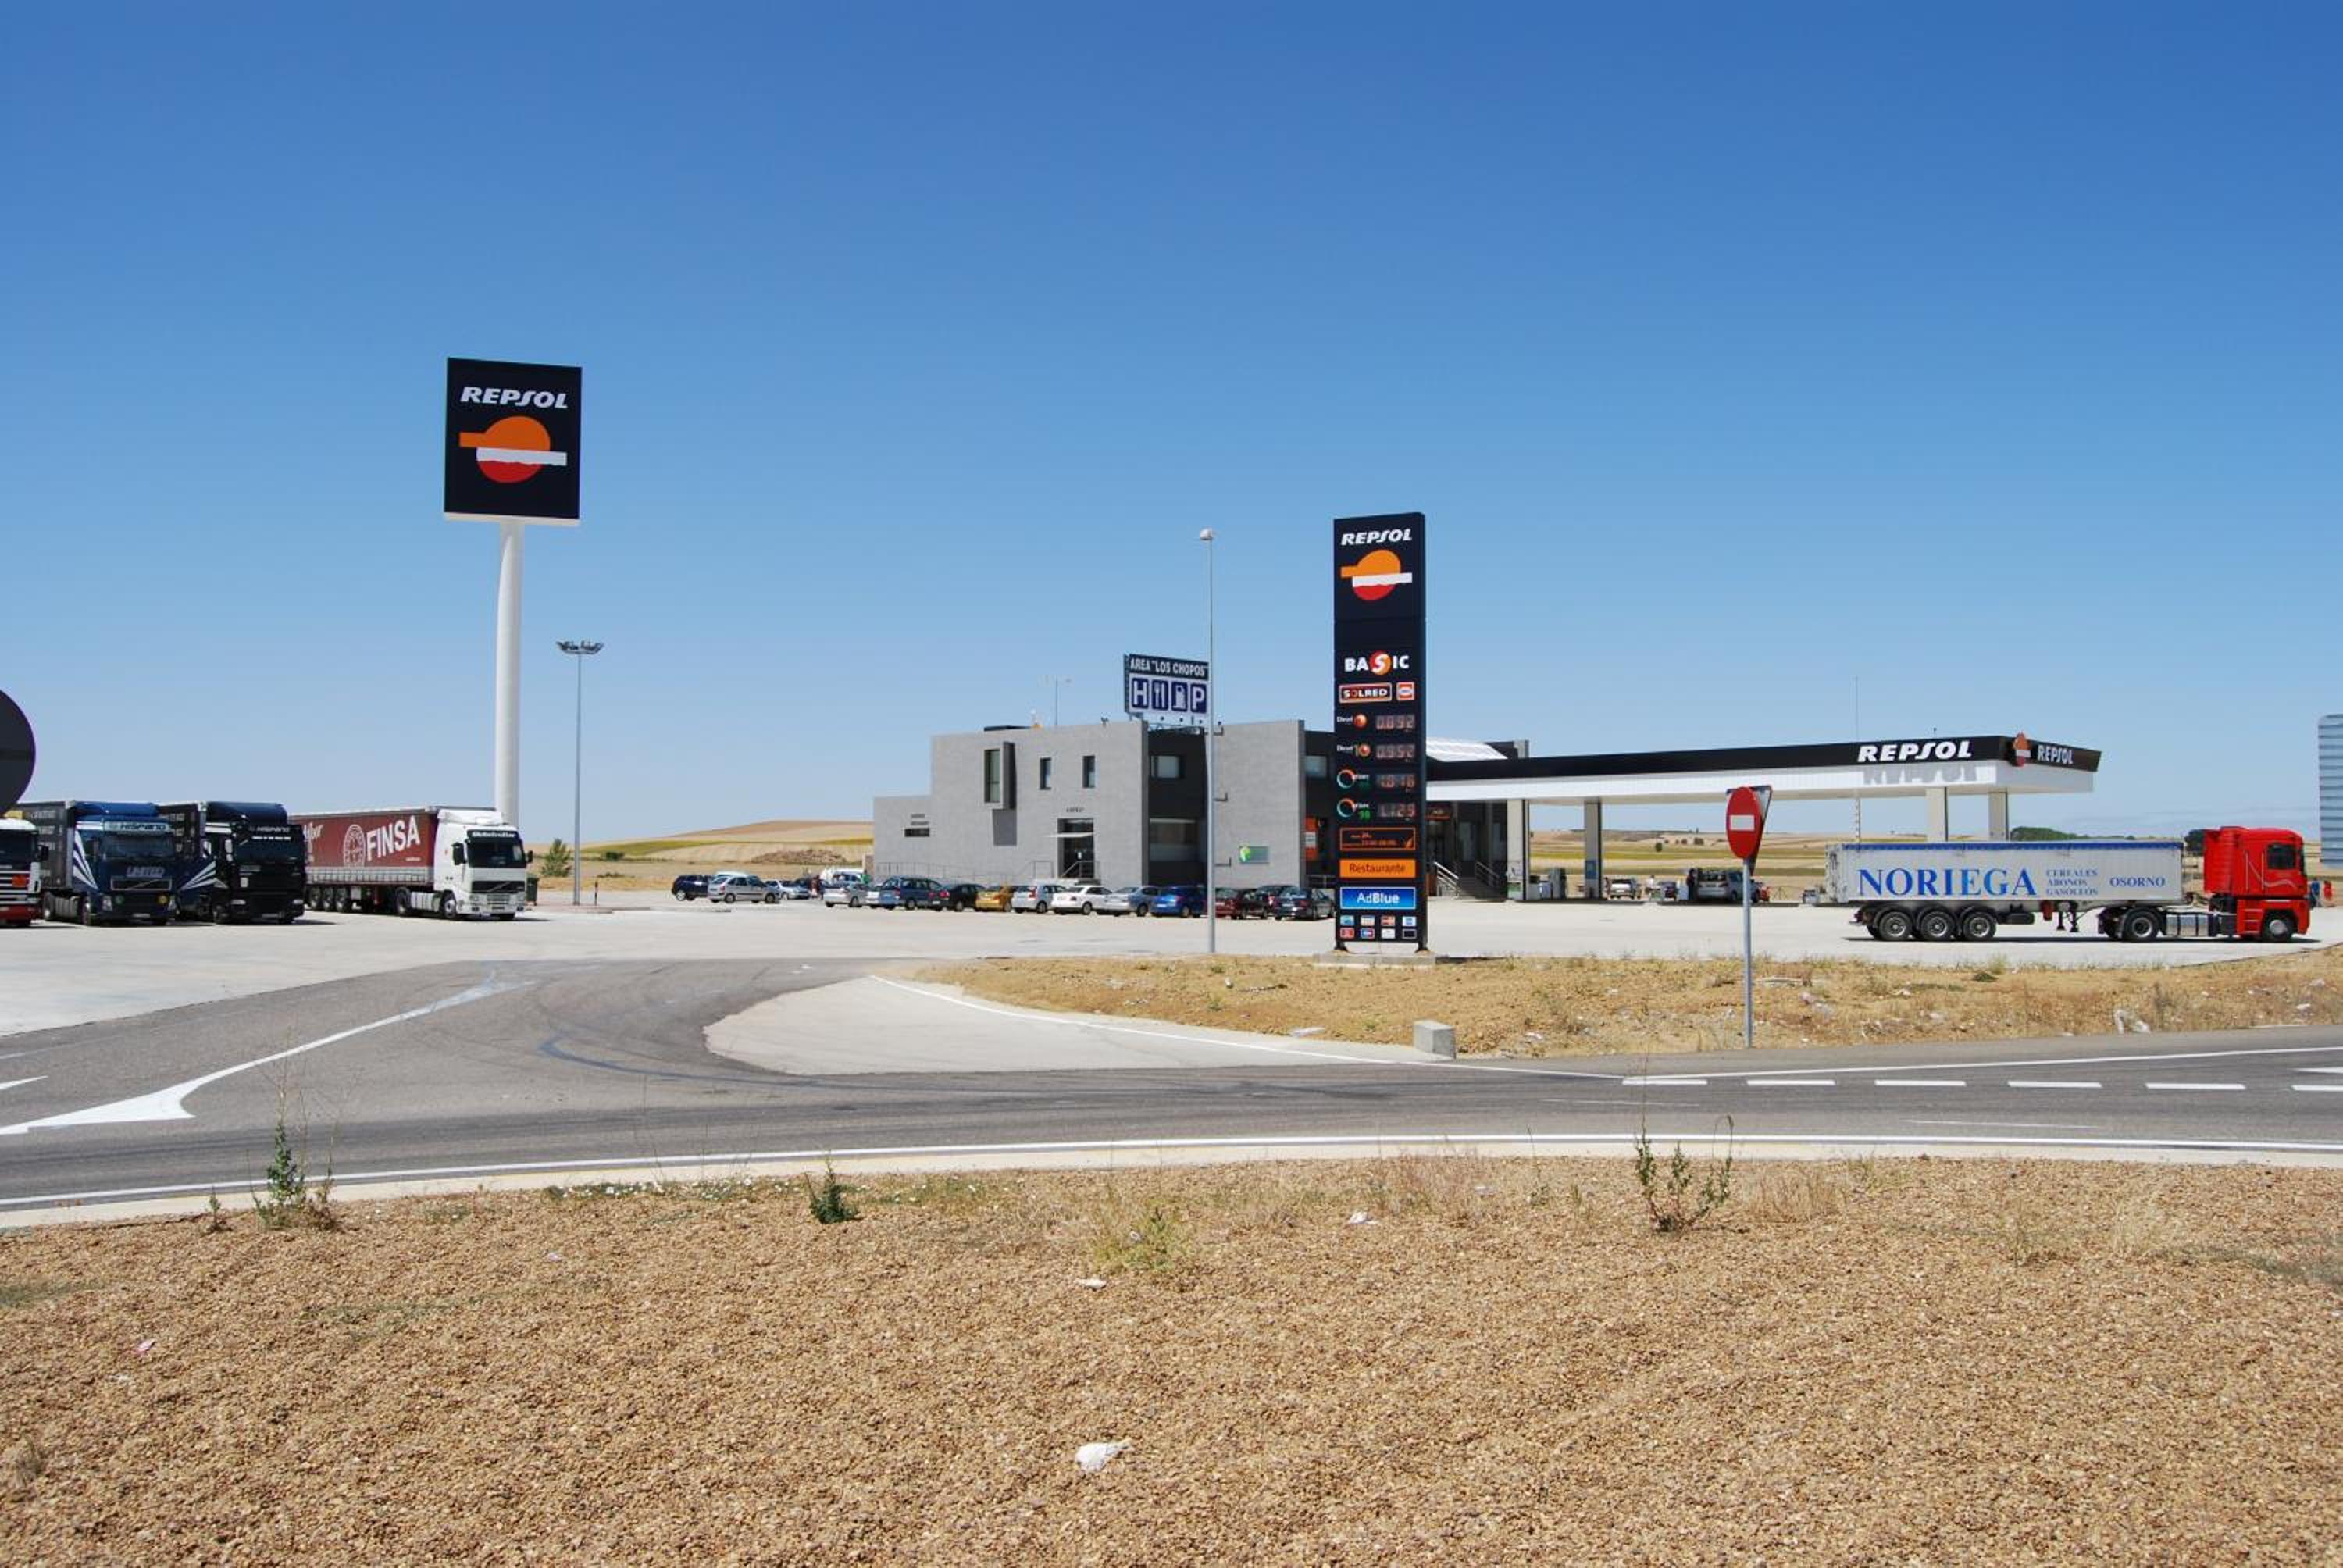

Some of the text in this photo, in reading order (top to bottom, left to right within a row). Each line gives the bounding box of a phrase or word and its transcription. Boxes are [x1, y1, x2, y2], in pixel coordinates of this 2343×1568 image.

[460, 386, 568, 408] REPSOL
[1341, 529, 1412, 545] REPSOL
[1130, 658, 1150, 671] AREA
[1344, 651, 1410, 675] BASIC
[1343, 688, 1388, 699] SOLRED
[1857, 741, 1972, 762] REPSOL
[2037, 744, 2074, 764] REPSOL
[366, 815, 421, 861] FINSA
[1350, 863, 1405, 873] Restaurante
[1857, 868, 2038, 896] NORIEGA
[2110, 877, 2166, 887] OSORNO
[1357, 893, 1400, 903] AdBlue
